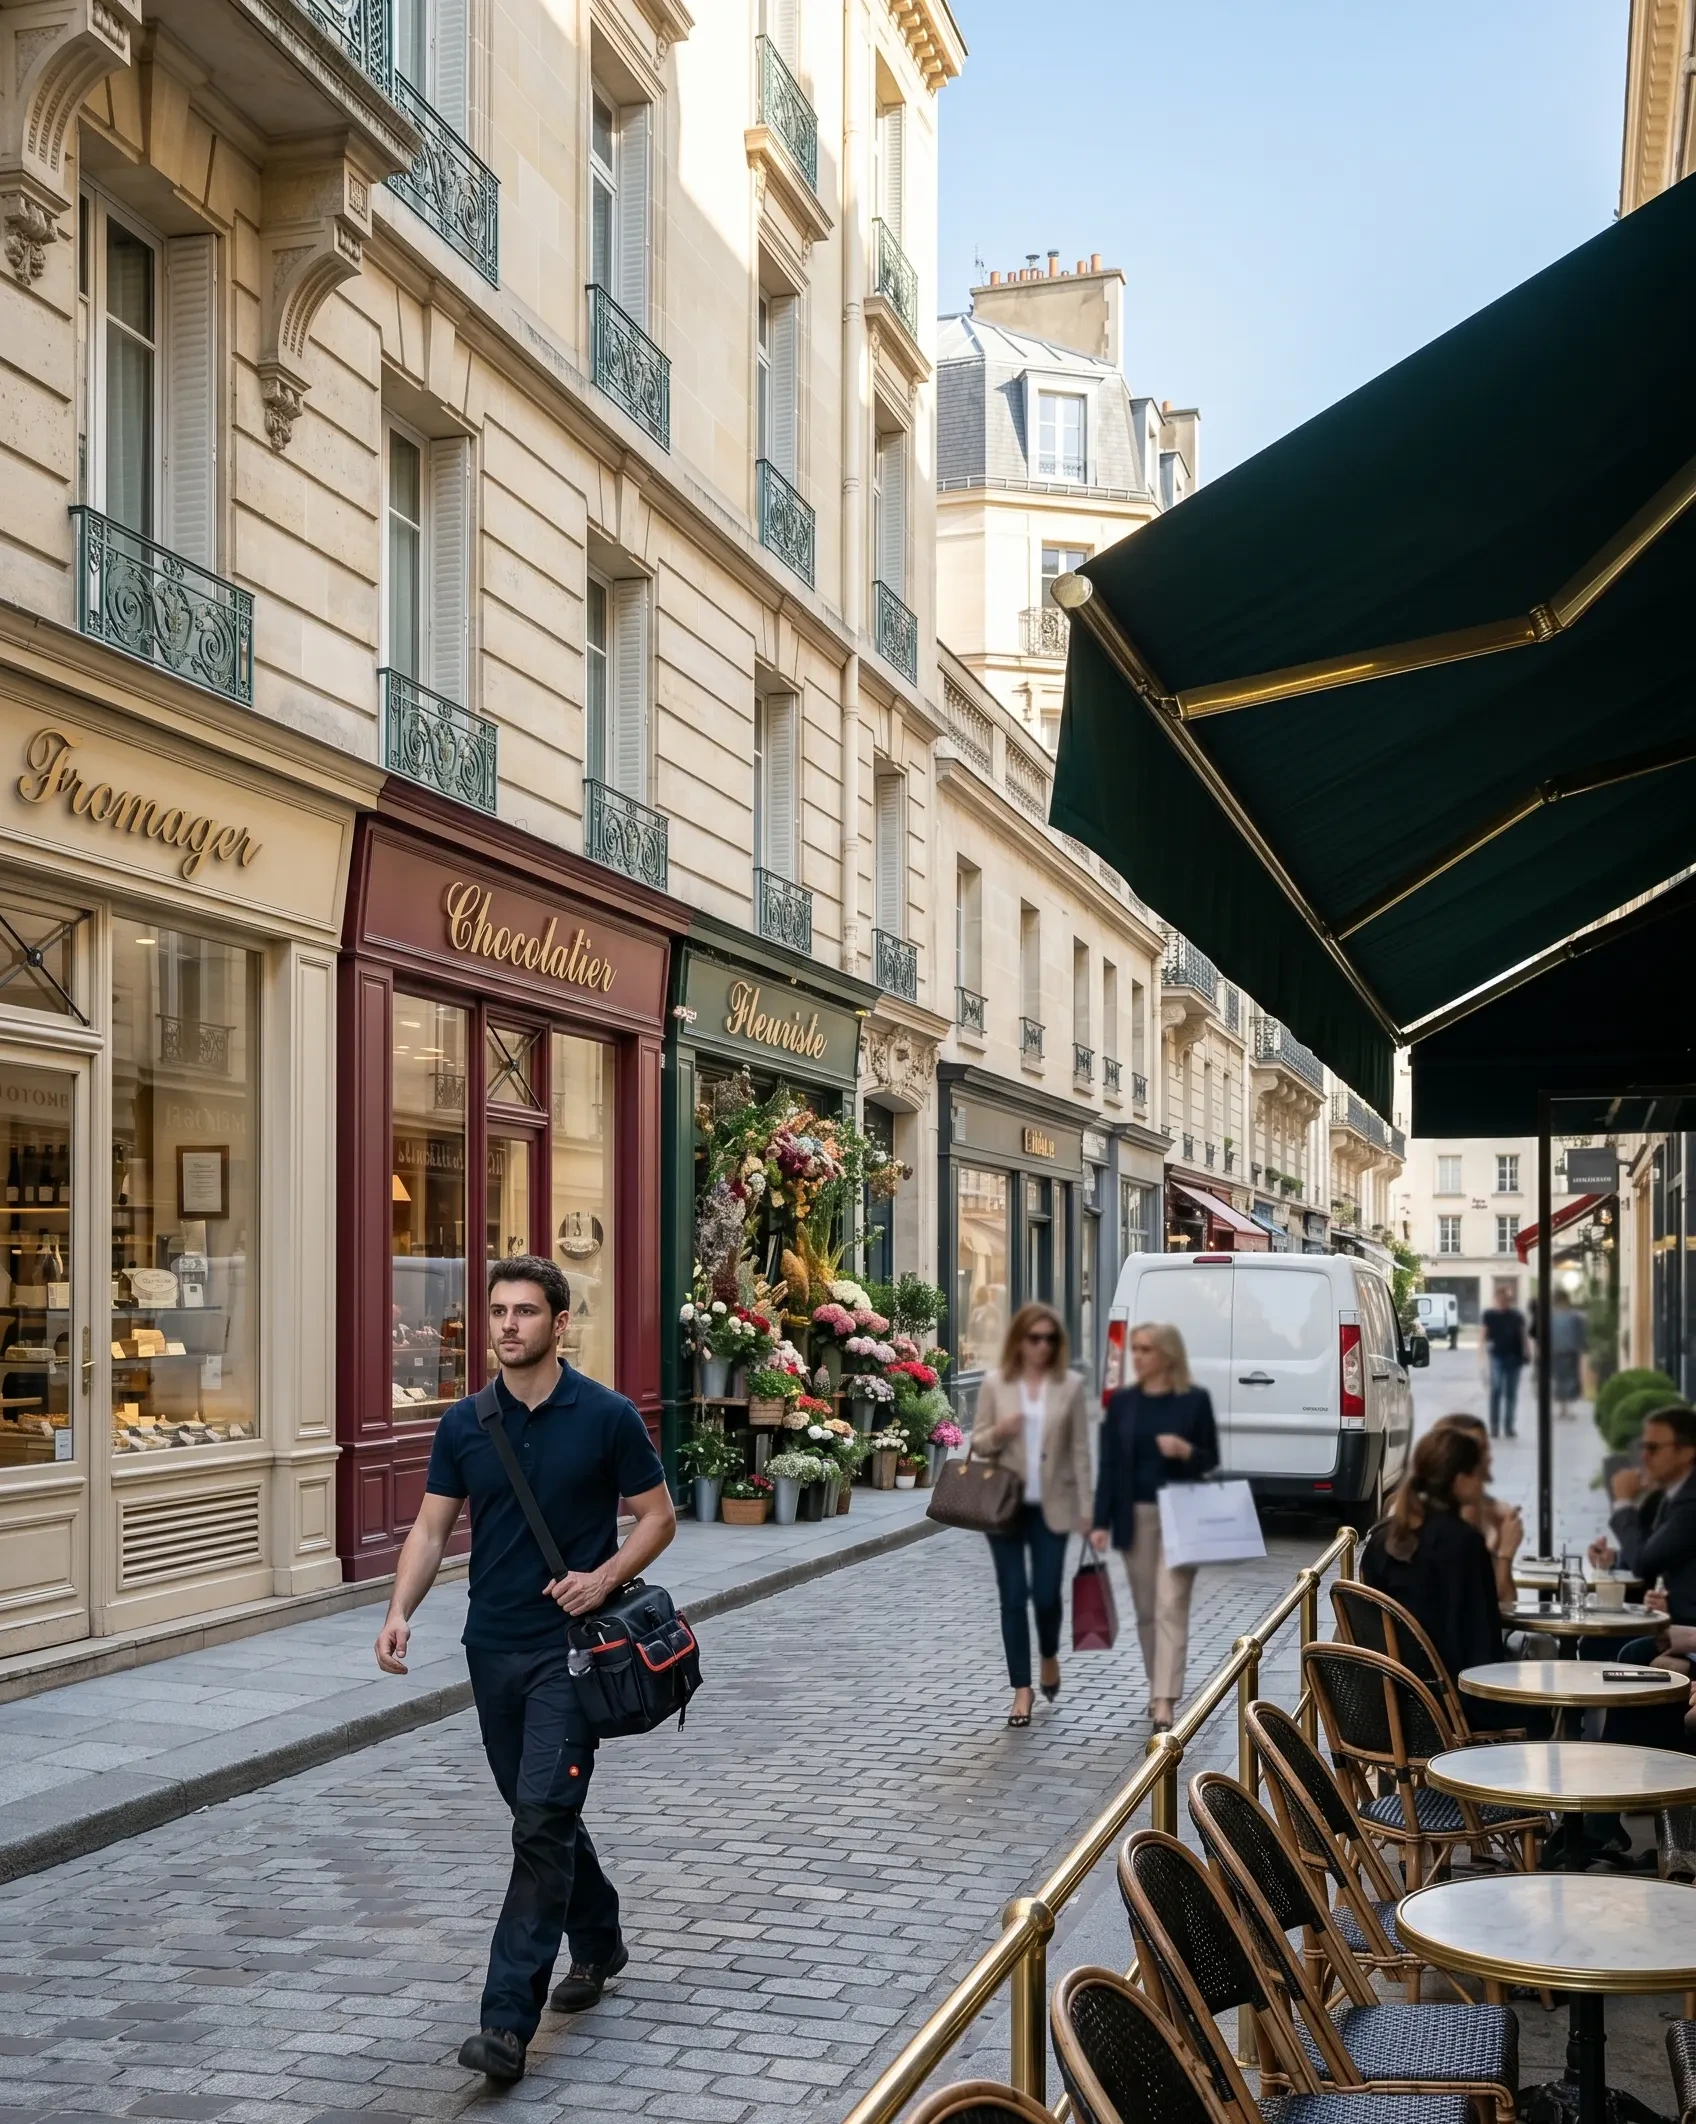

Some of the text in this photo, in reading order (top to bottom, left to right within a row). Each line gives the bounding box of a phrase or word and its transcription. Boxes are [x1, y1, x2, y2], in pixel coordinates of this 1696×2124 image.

[17, 727, 263, 880] Fromager
[447, 881, 617, 992] Chocolatier
[726, 981, 828, 1060] Fleuriste
